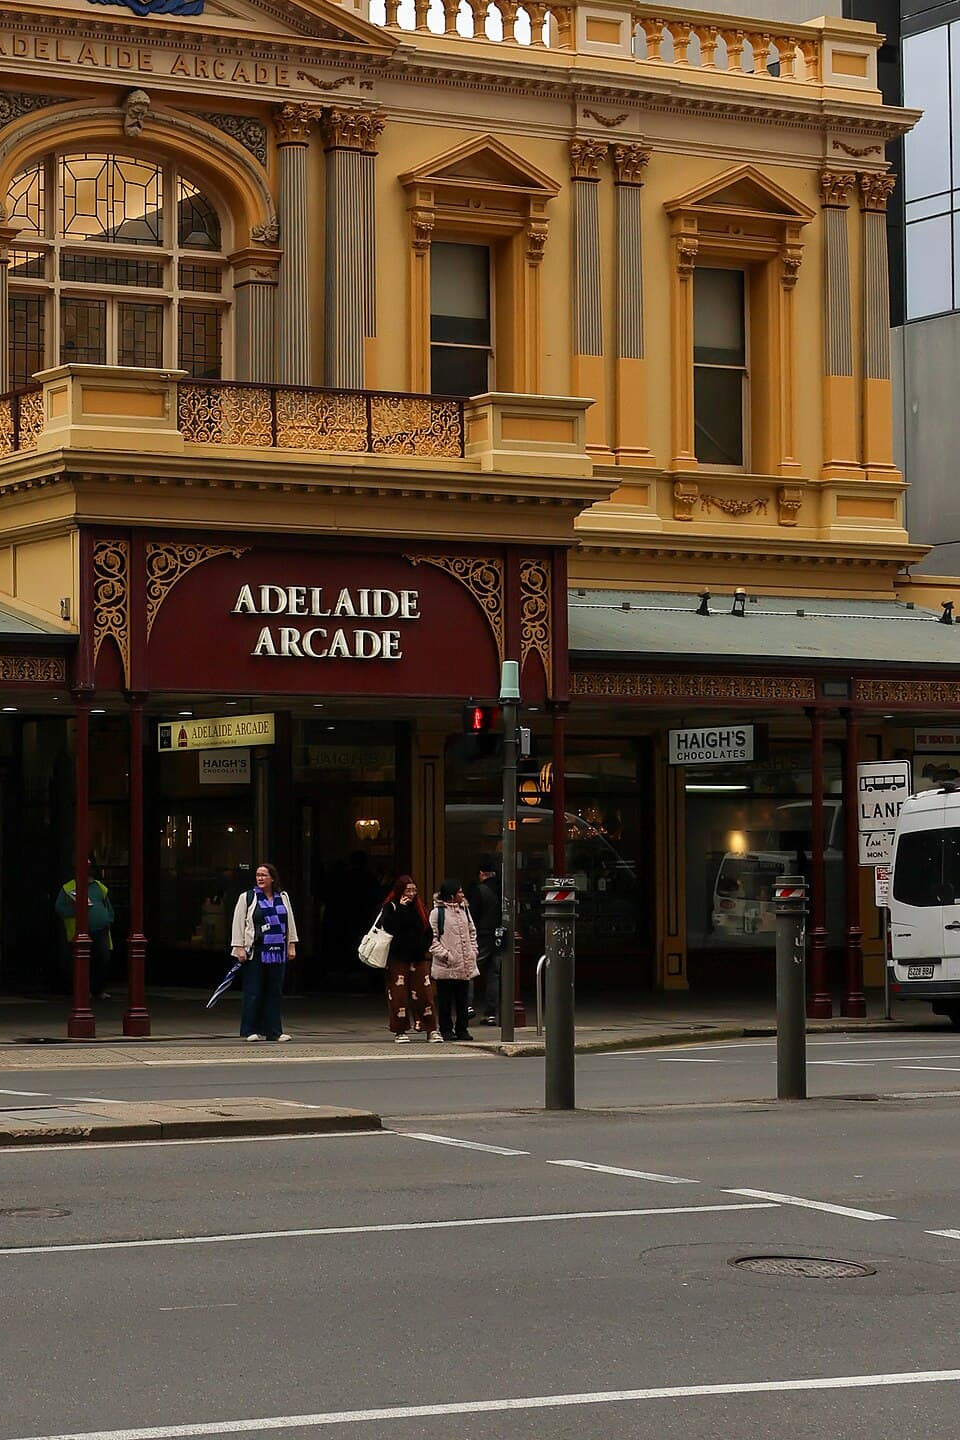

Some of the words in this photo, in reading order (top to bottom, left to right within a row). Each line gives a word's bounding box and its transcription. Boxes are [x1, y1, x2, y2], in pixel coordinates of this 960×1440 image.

[170, 54, 291, 87] ARCADE
[230, 583, 421, 620] ADELAIDE
[250, 626, 403, 660] ARCADE
[191, 723, 233, 739] ADELAIDE
[235, 720, 269, 736] ARCADE
[677, 730, 746, 749] HAIGH'S
[202, 759, 247, 768] HAIGH'S
[677, 750, 746, 761] CHOCOLATES
